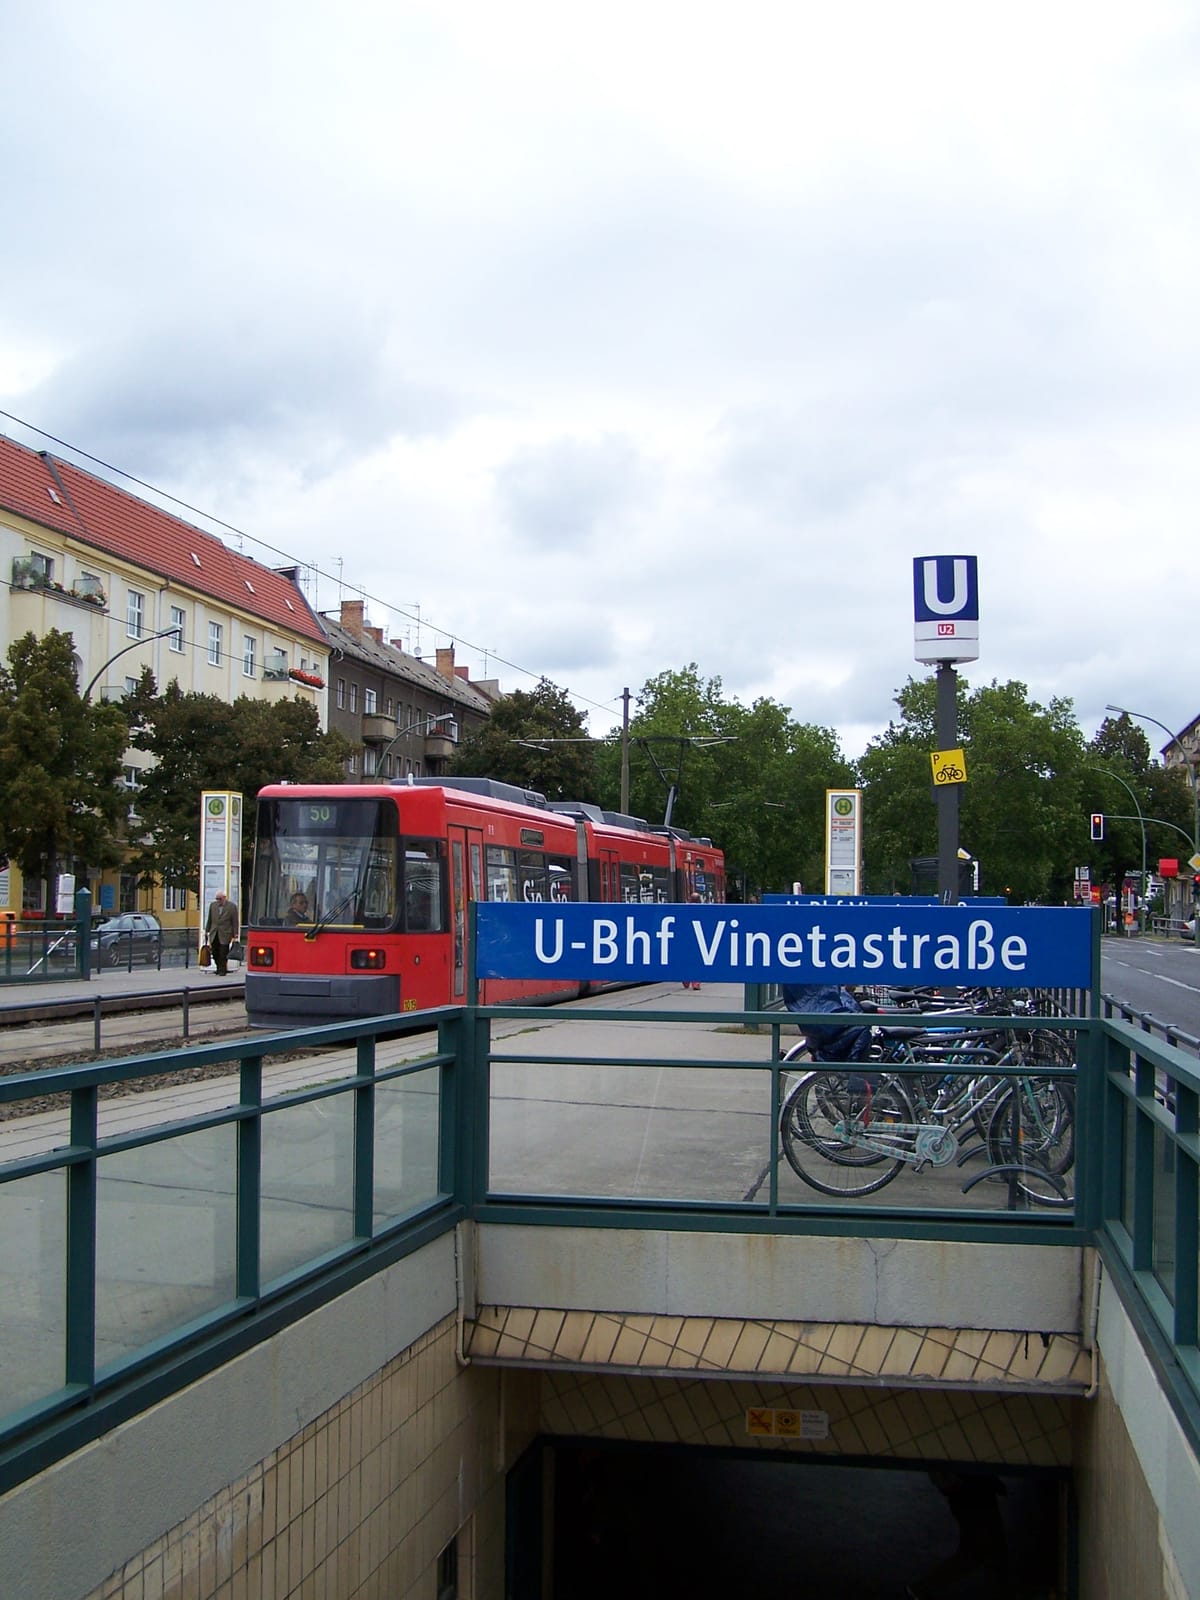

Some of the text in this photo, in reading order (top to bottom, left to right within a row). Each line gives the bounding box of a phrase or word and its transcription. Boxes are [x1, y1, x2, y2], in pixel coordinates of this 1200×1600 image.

[923, 559, 968, 615] U
[939, 625, 954, 635] U2
[932, 754, 940, 764] P
[310, 805, 330, 822] 50
[535, 916, 1029, 971] U-Bhf Vinetastraße
